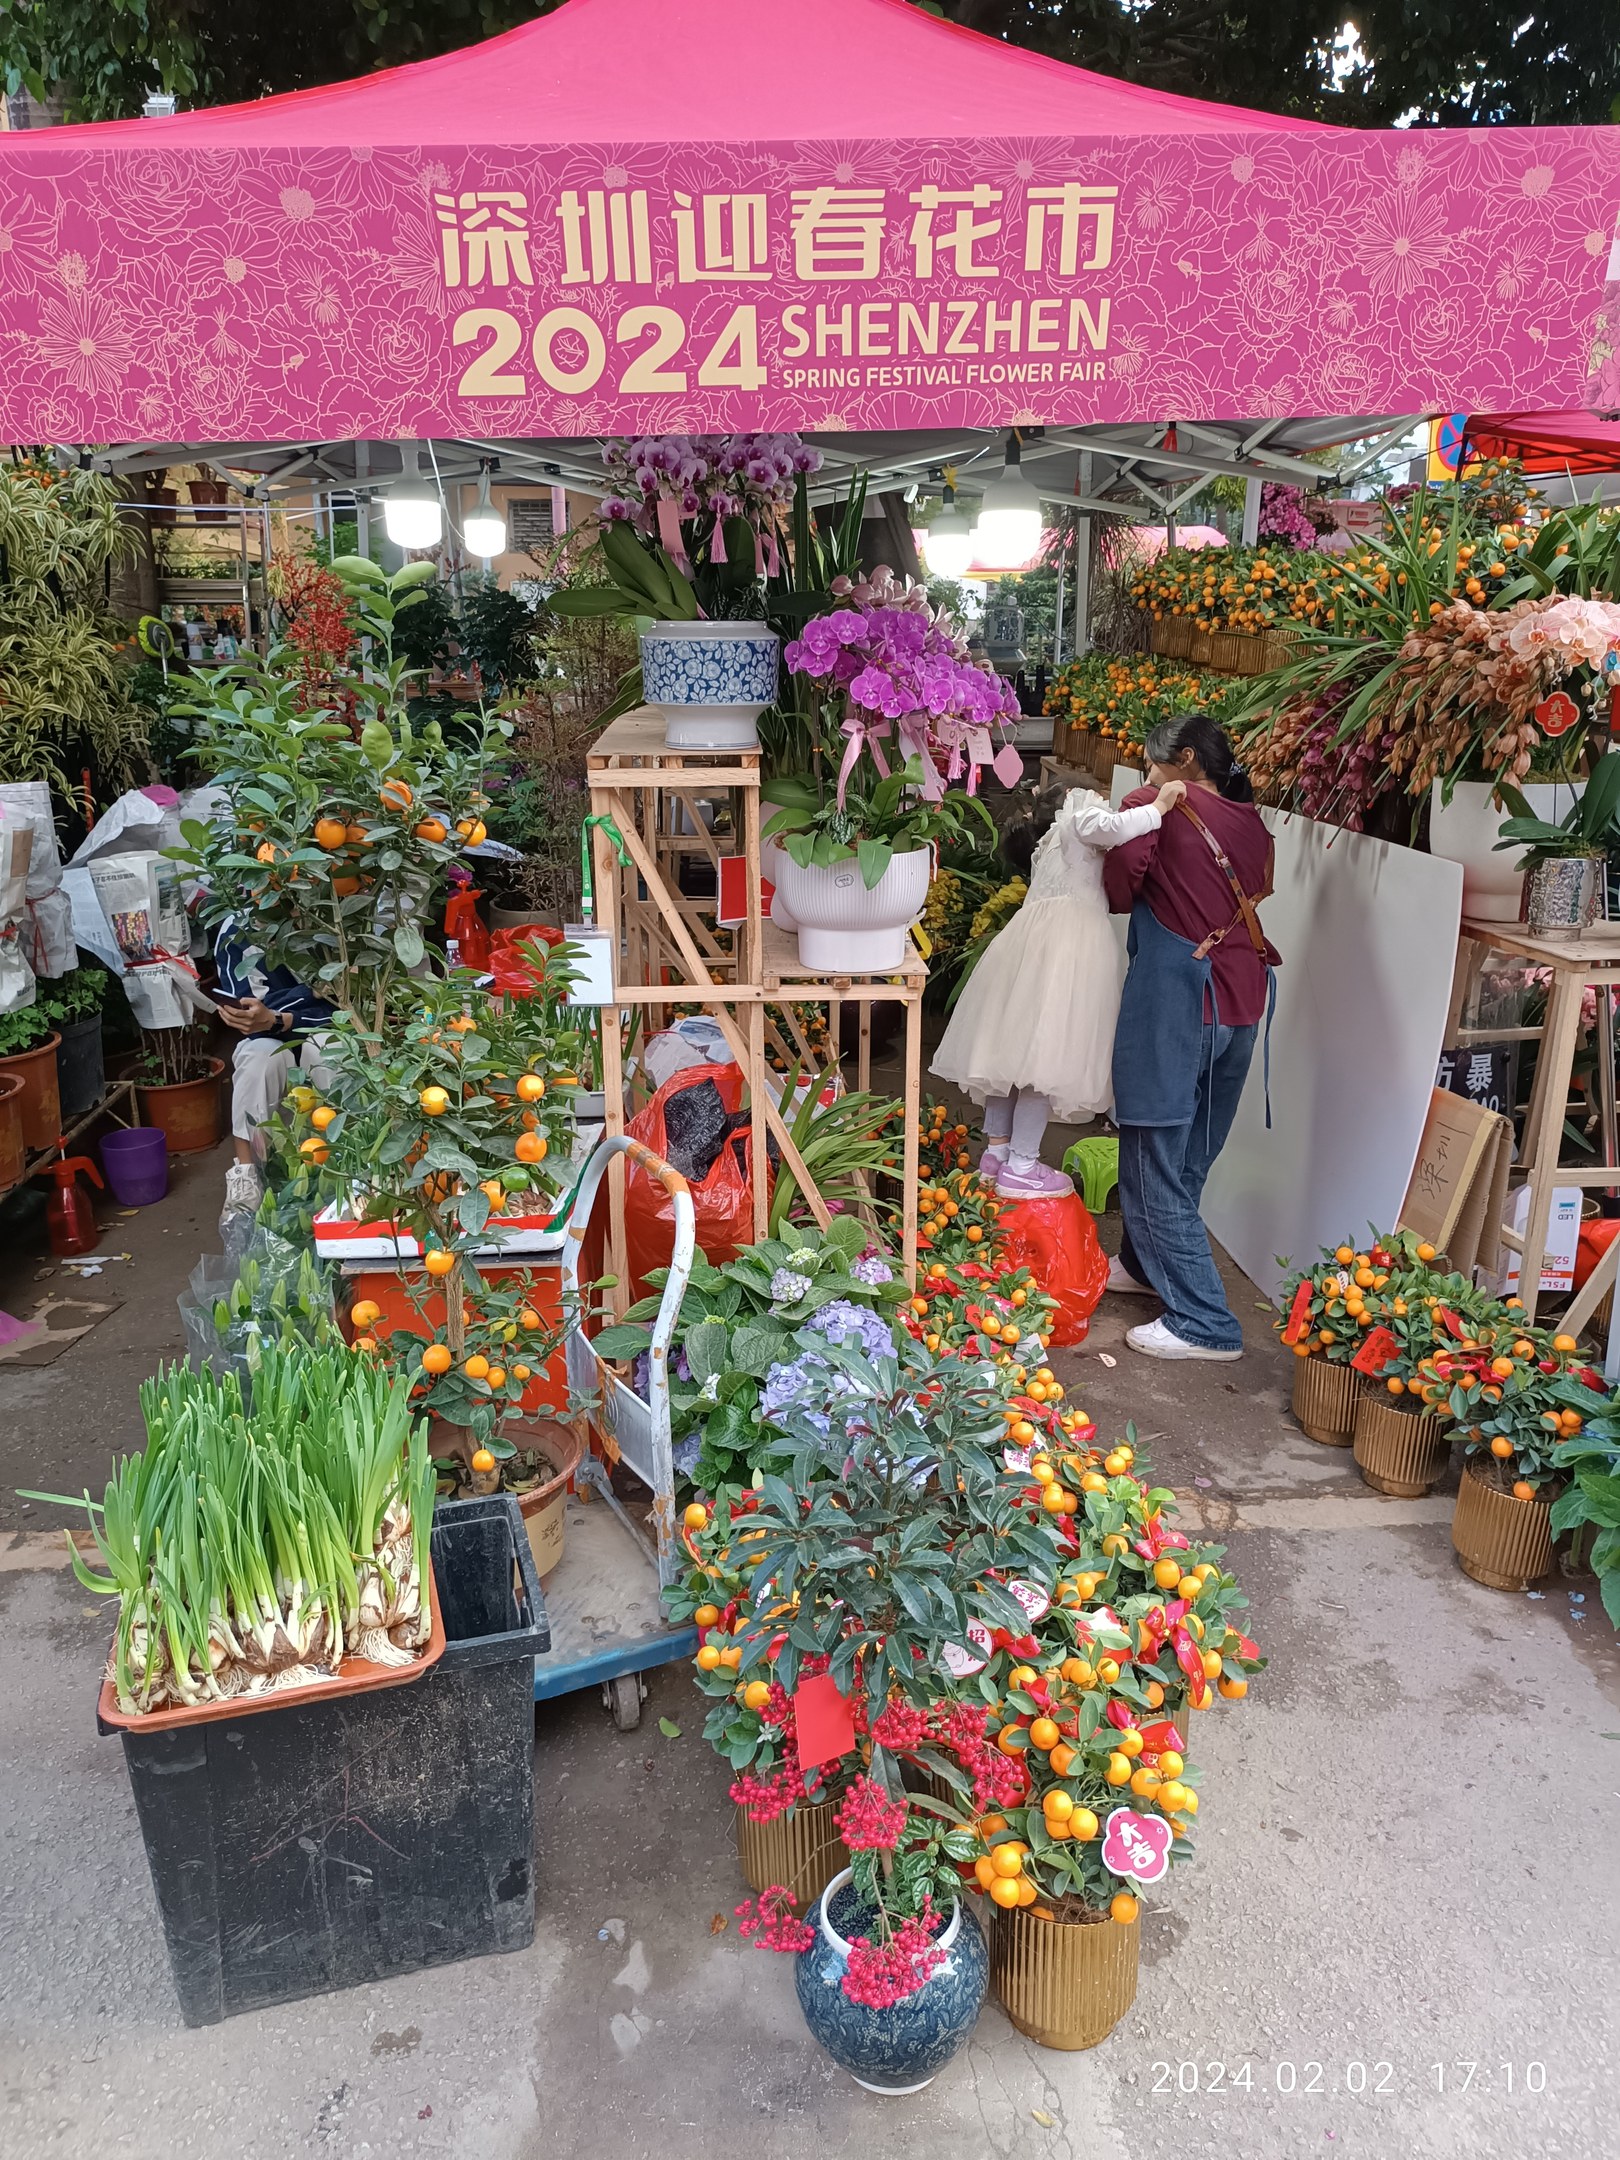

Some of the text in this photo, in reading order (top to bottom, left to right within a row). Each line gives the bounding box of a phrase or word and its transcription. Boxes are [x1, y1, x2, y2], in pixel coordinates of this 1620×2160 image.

[435, 182, 1119, 288] 深圳迎春花市
[452, 305, 769, 397] 2024
[782, 299, 1112, 358] SHENZHEN
[782, 361, 1107, 389] SPRING FESTIVAL FLOWER FAIR
[1116, 1821, 1157, 1870] 大吉
